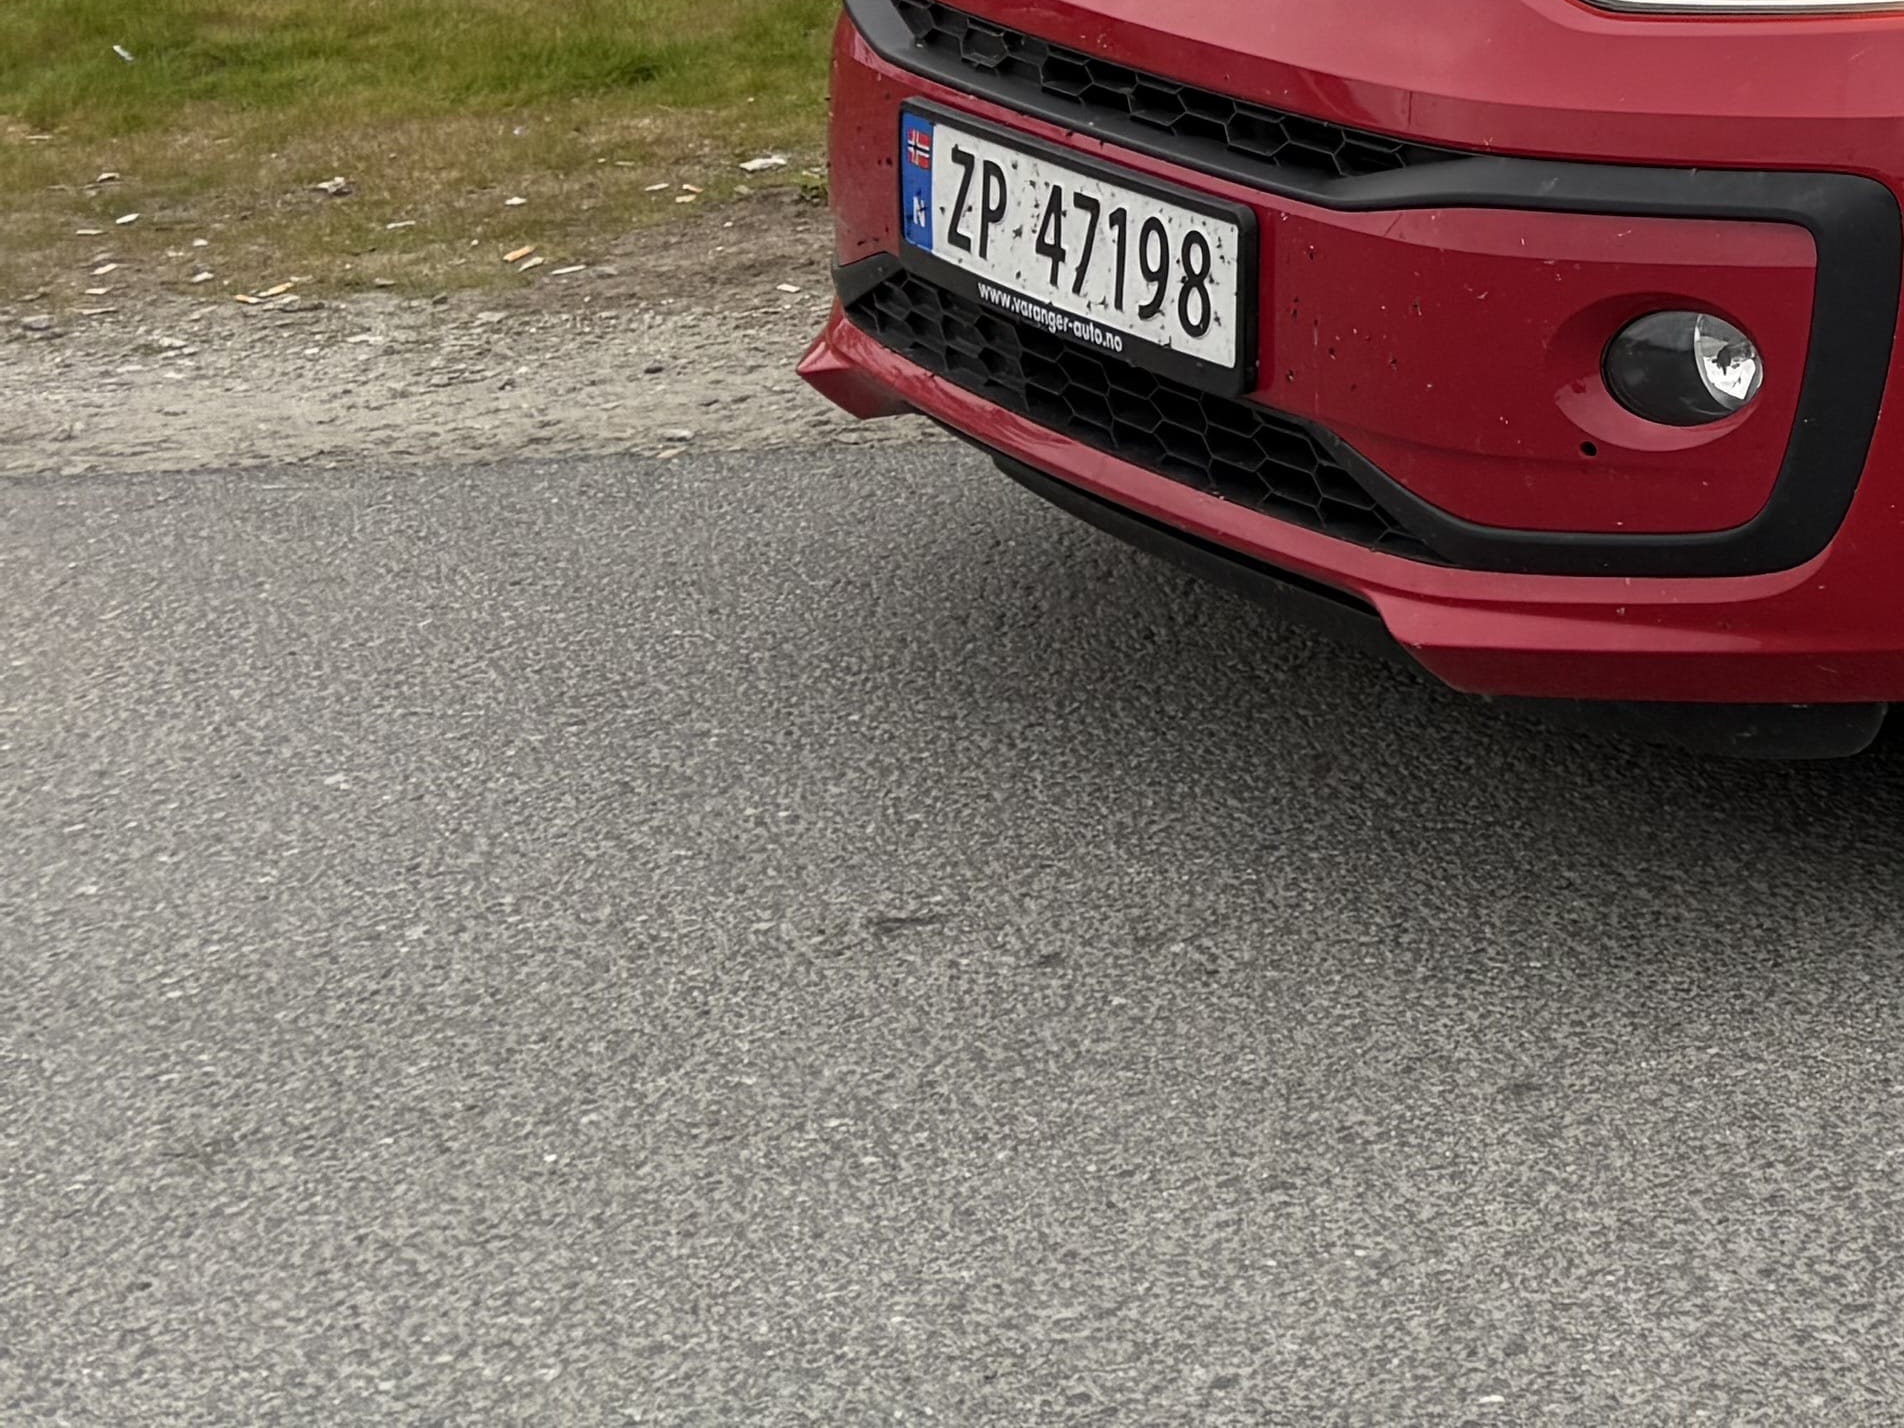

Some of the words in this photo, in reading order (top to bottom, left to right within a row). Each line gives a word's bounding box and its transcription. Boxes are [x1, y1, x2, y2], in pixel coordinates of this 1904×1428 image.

[947, 144, 1007, 260] ZP
[1035, 184, 1211, 338] 47198
[977, 281, 1123, 352] www.varanger-auto.no
